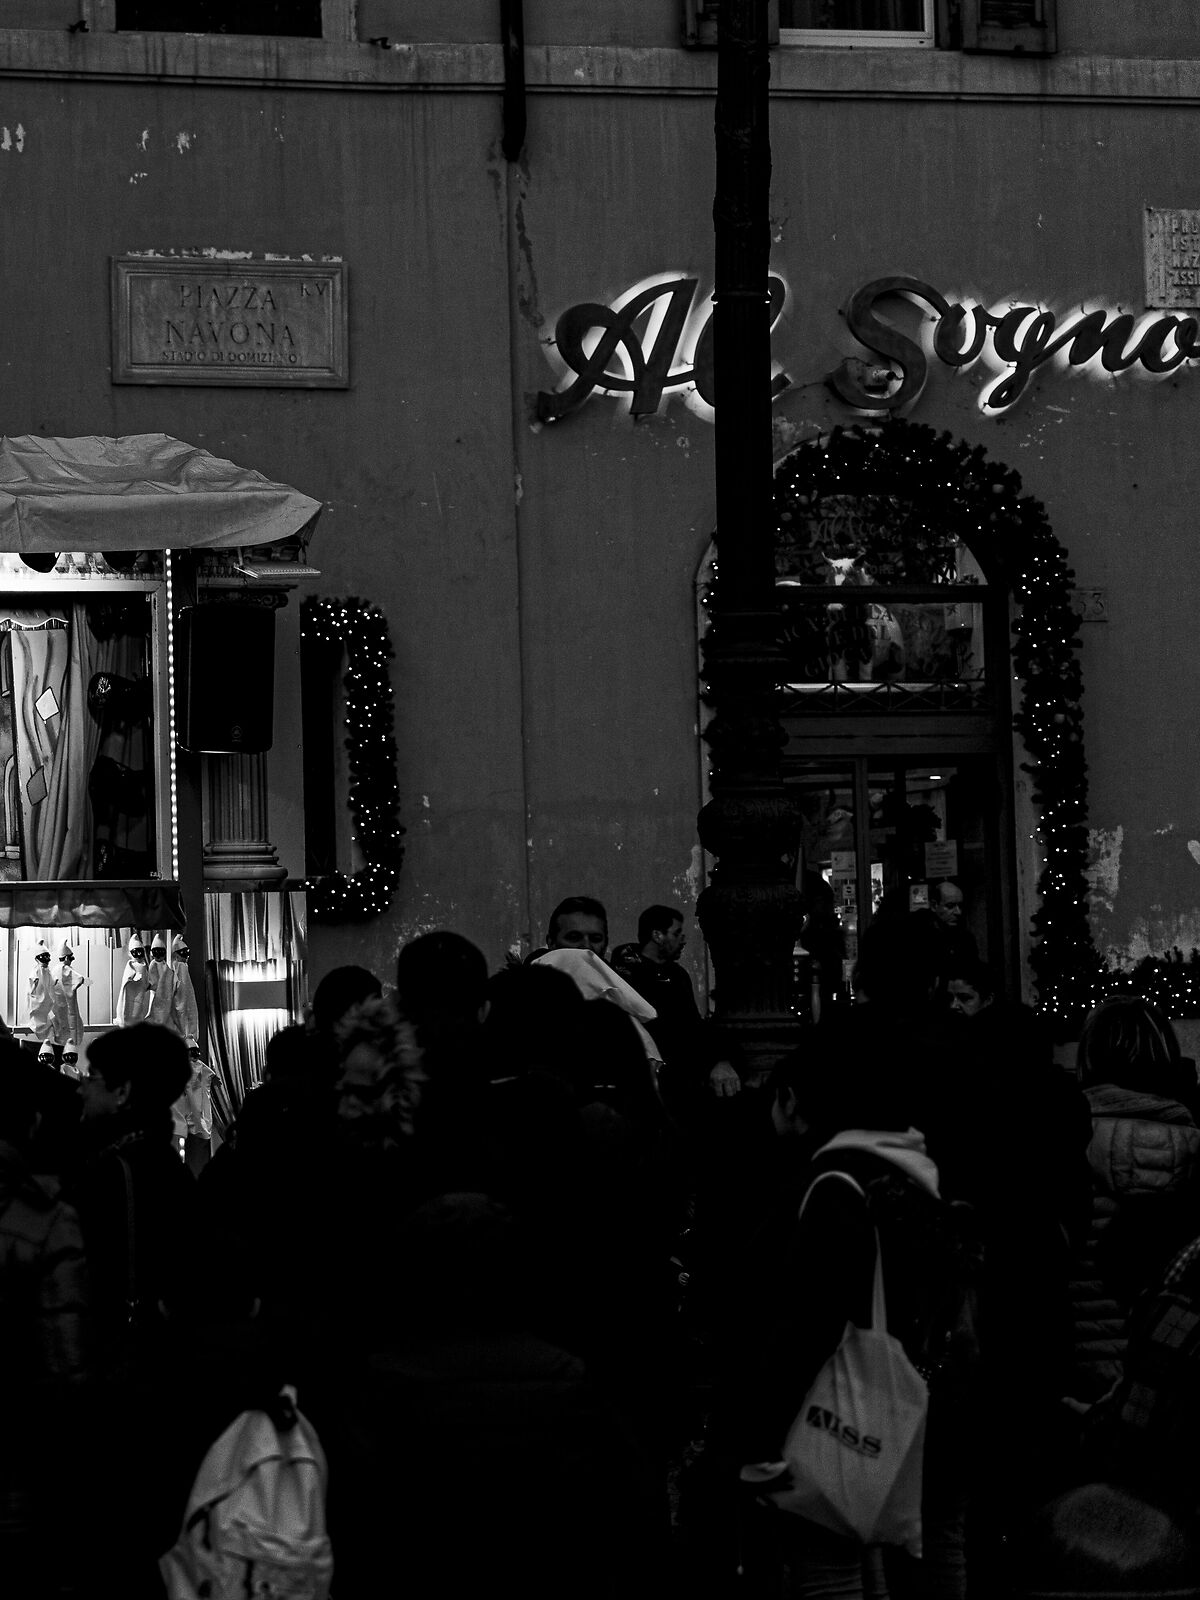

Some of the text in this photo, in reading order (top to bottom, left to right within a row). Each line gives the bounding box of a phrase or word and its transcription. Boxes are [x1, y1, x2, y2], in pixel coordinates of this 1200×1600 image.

[1173, 271, 1200, 286] ASSI
[180, 285, 277, 310] PIAZZA
[166, 320, 295, 346] NAVONA
[826, 276, 1200, 410] Sogno
[211, 351, 224, 362] DI
[228, 352, 298, 363] DOMIZIO
